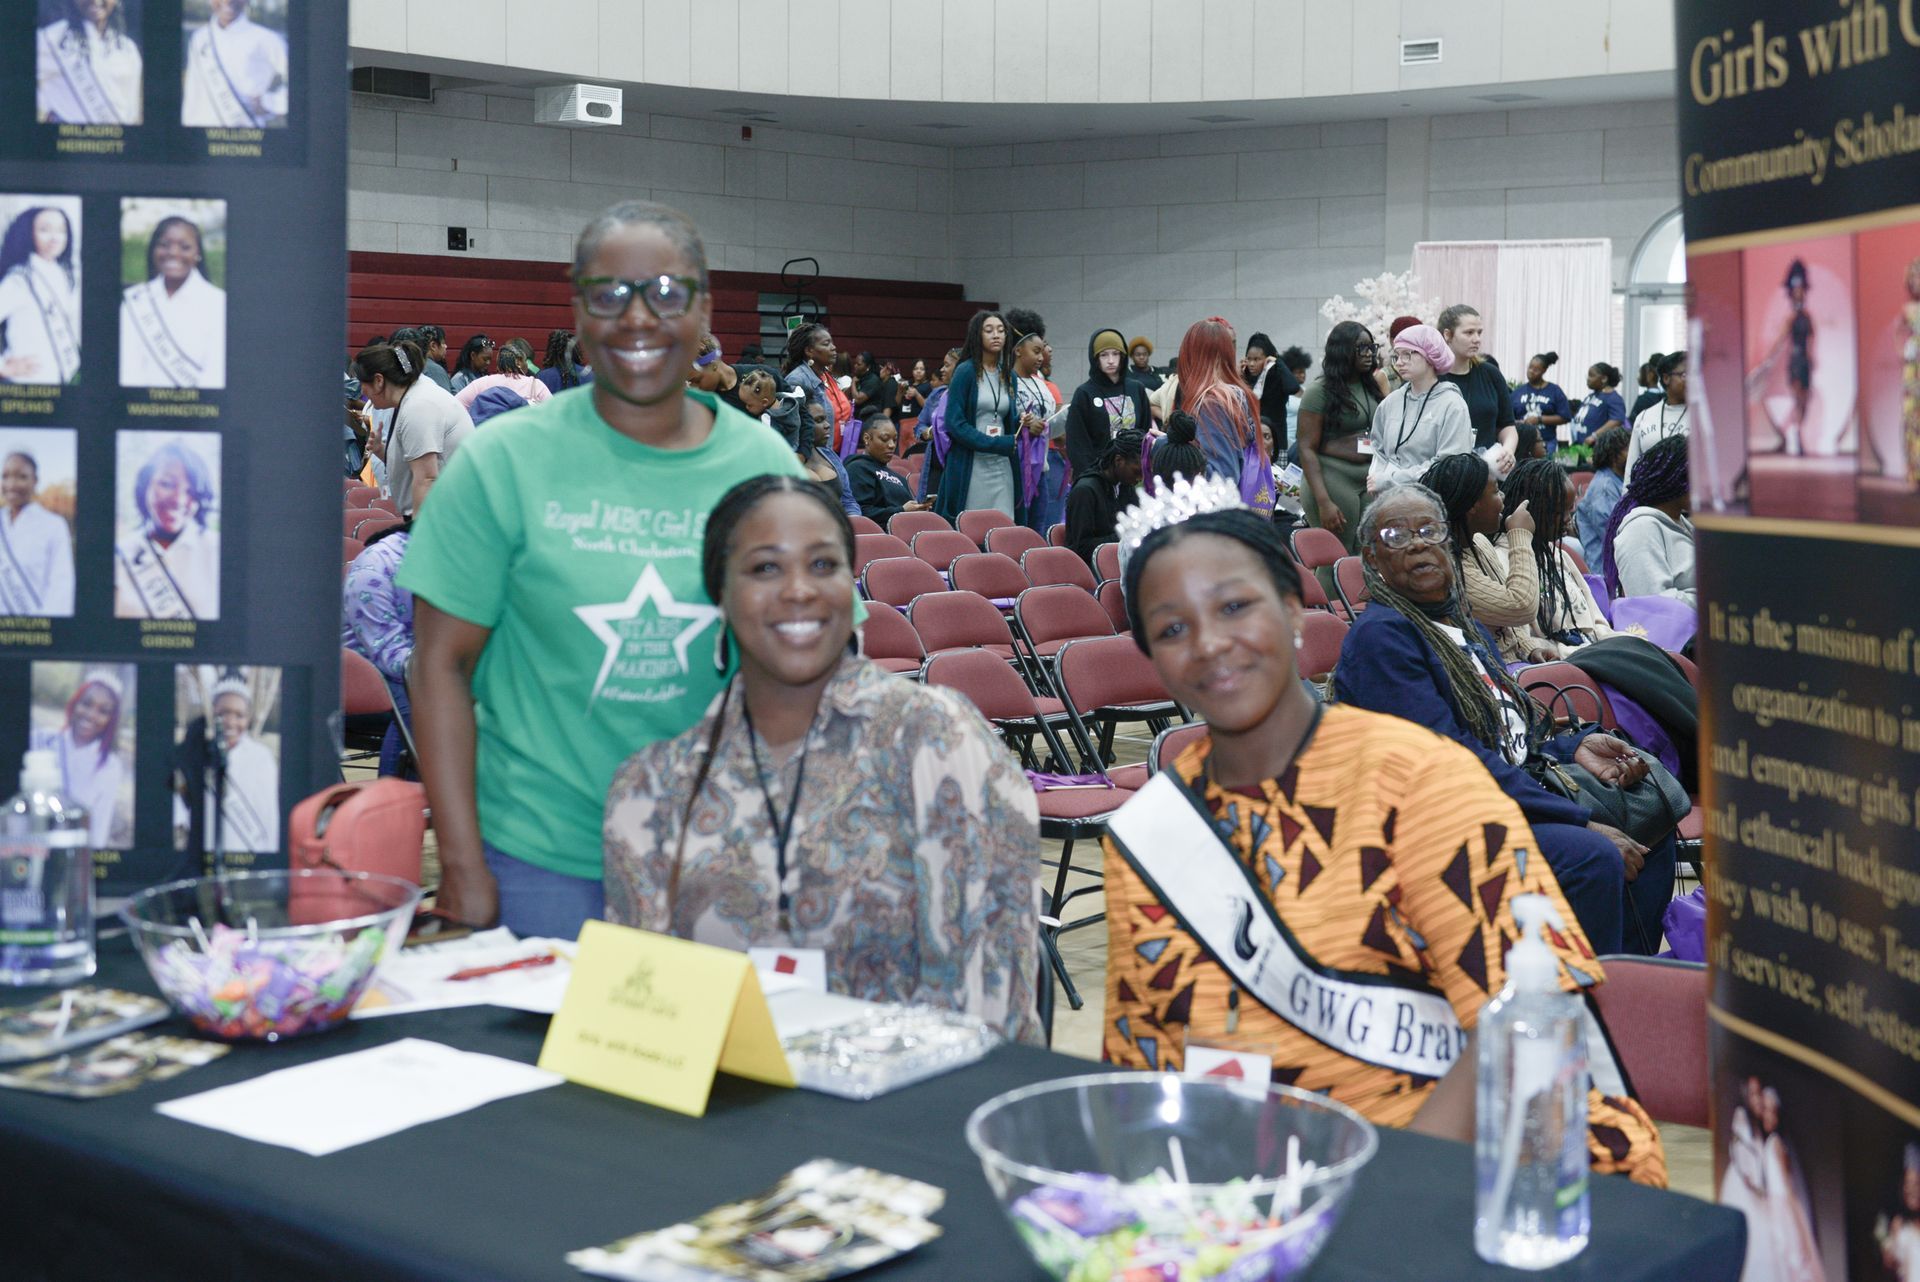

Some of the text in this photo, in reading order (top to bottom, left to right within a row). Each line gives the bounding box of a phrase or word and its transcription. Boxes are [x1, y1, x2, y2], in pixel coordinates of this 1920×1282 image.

[1690, 19, 1789, 106] Girls
[1798, 0, 1889, 78] with
[206, 127, 265, 142] WILLOW
[208, 142, 262, 157] BROWN
[1685, 103, 1920, 197] Community Schola
[127, 402, 220, 417] WASHINGTON
[149, 388, 200, 401] TAYLOR
[1640, 424, 1656, 438] AIR
[544, 500, 599, 534] Royal
[602, 503, 651, 536] MBC
[654, 508, 691, 539] Girl
[572, 535, 617, 553] North
[141, 634, 195, 648] GIBSON
[1709, 601, 1726, 641] It
[1728, 603, 1750, 645] is
[1752, 607, 1793, 651] the
[1797, 614, 1881, 668] mission
[1882, 628, 1914, 673] of
[1732, 681, 1873, 740] organization
[1874, 705, 1899, 747] to
[1751, 754, 1859, 807] empower
[1860, 772, 1911, 827] girls
[1750, 881, 1809, 933] wish
[1811, 903, 1837, 943] to
[1731, 948, 1822, 1010] service,
[1289, 973, 1373, 1046] GWG
